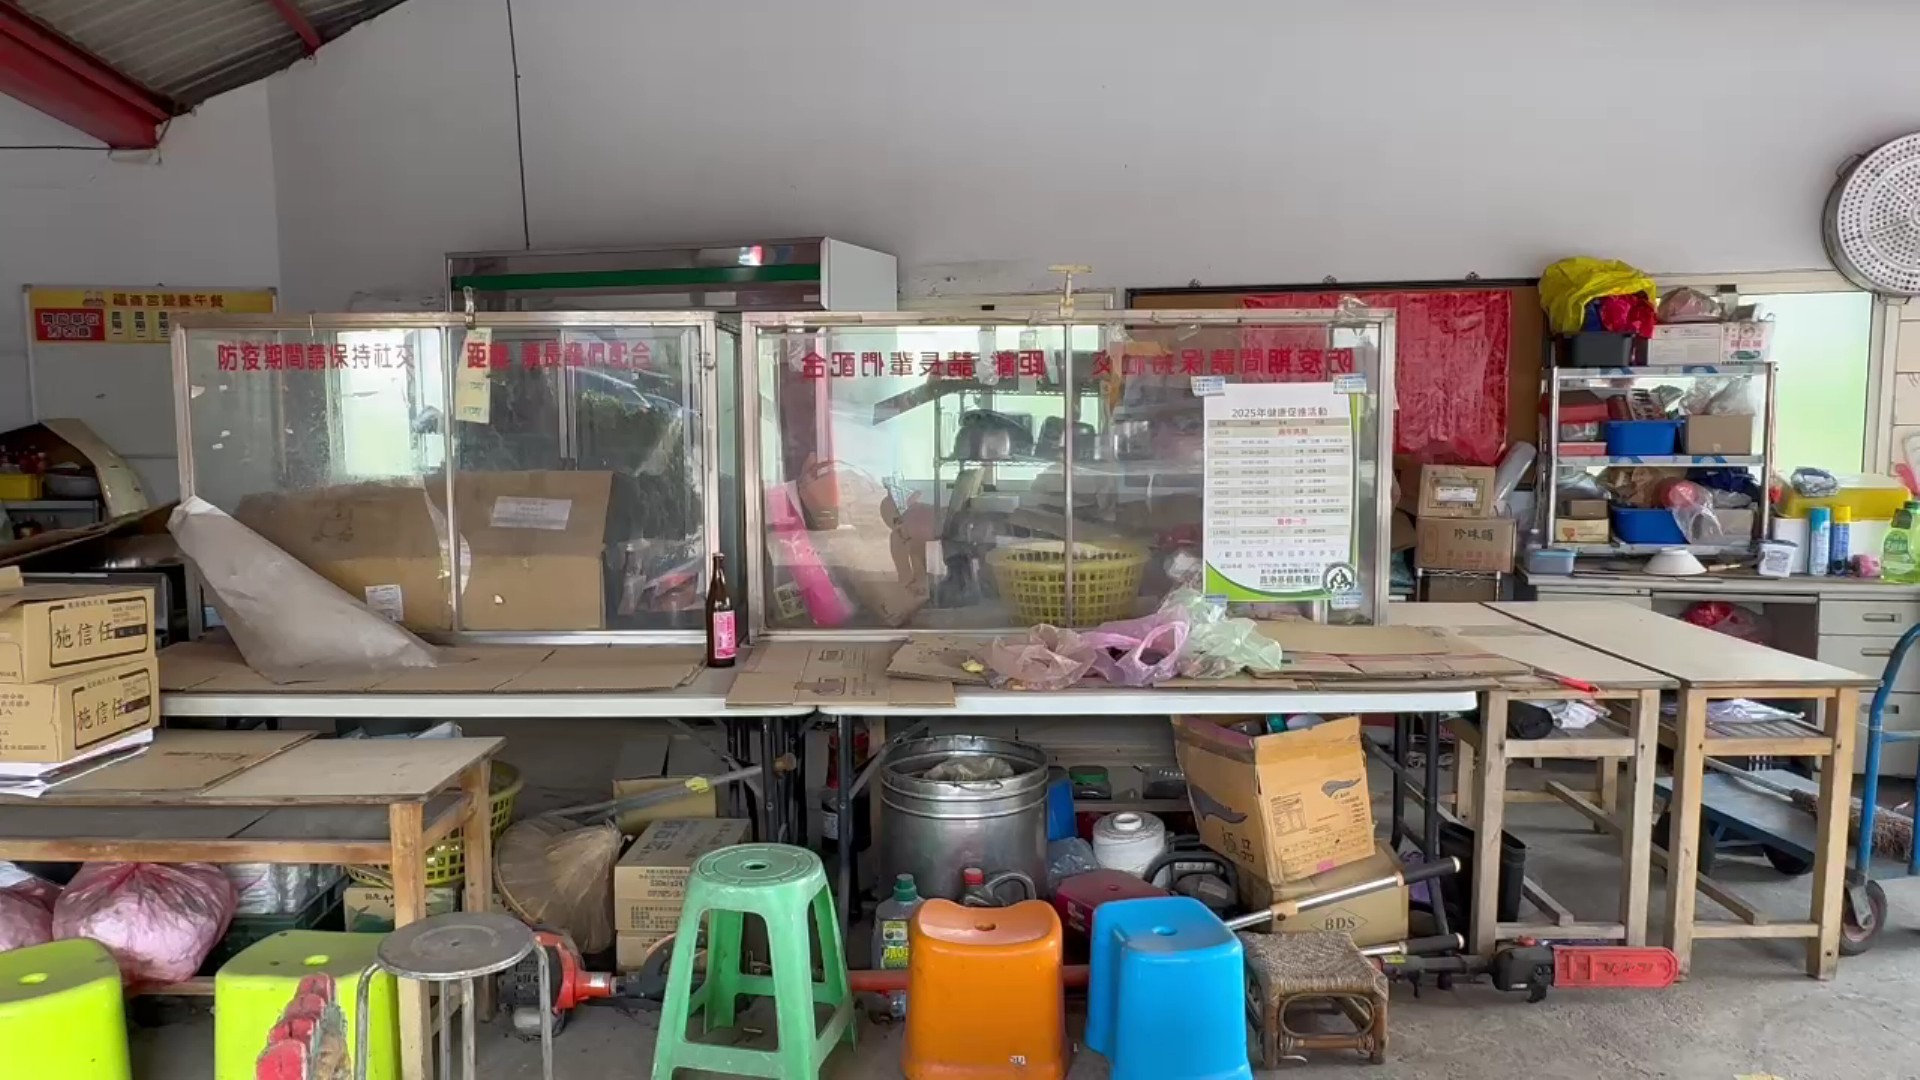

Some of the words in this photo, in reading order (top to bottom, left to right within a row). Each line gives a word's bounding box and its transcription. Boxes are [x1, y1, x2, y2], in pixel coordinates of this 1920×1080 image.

[217, 343, 416, 370] 防疫期間請保持社交
[1325, 917, 1355, 931] BDS
